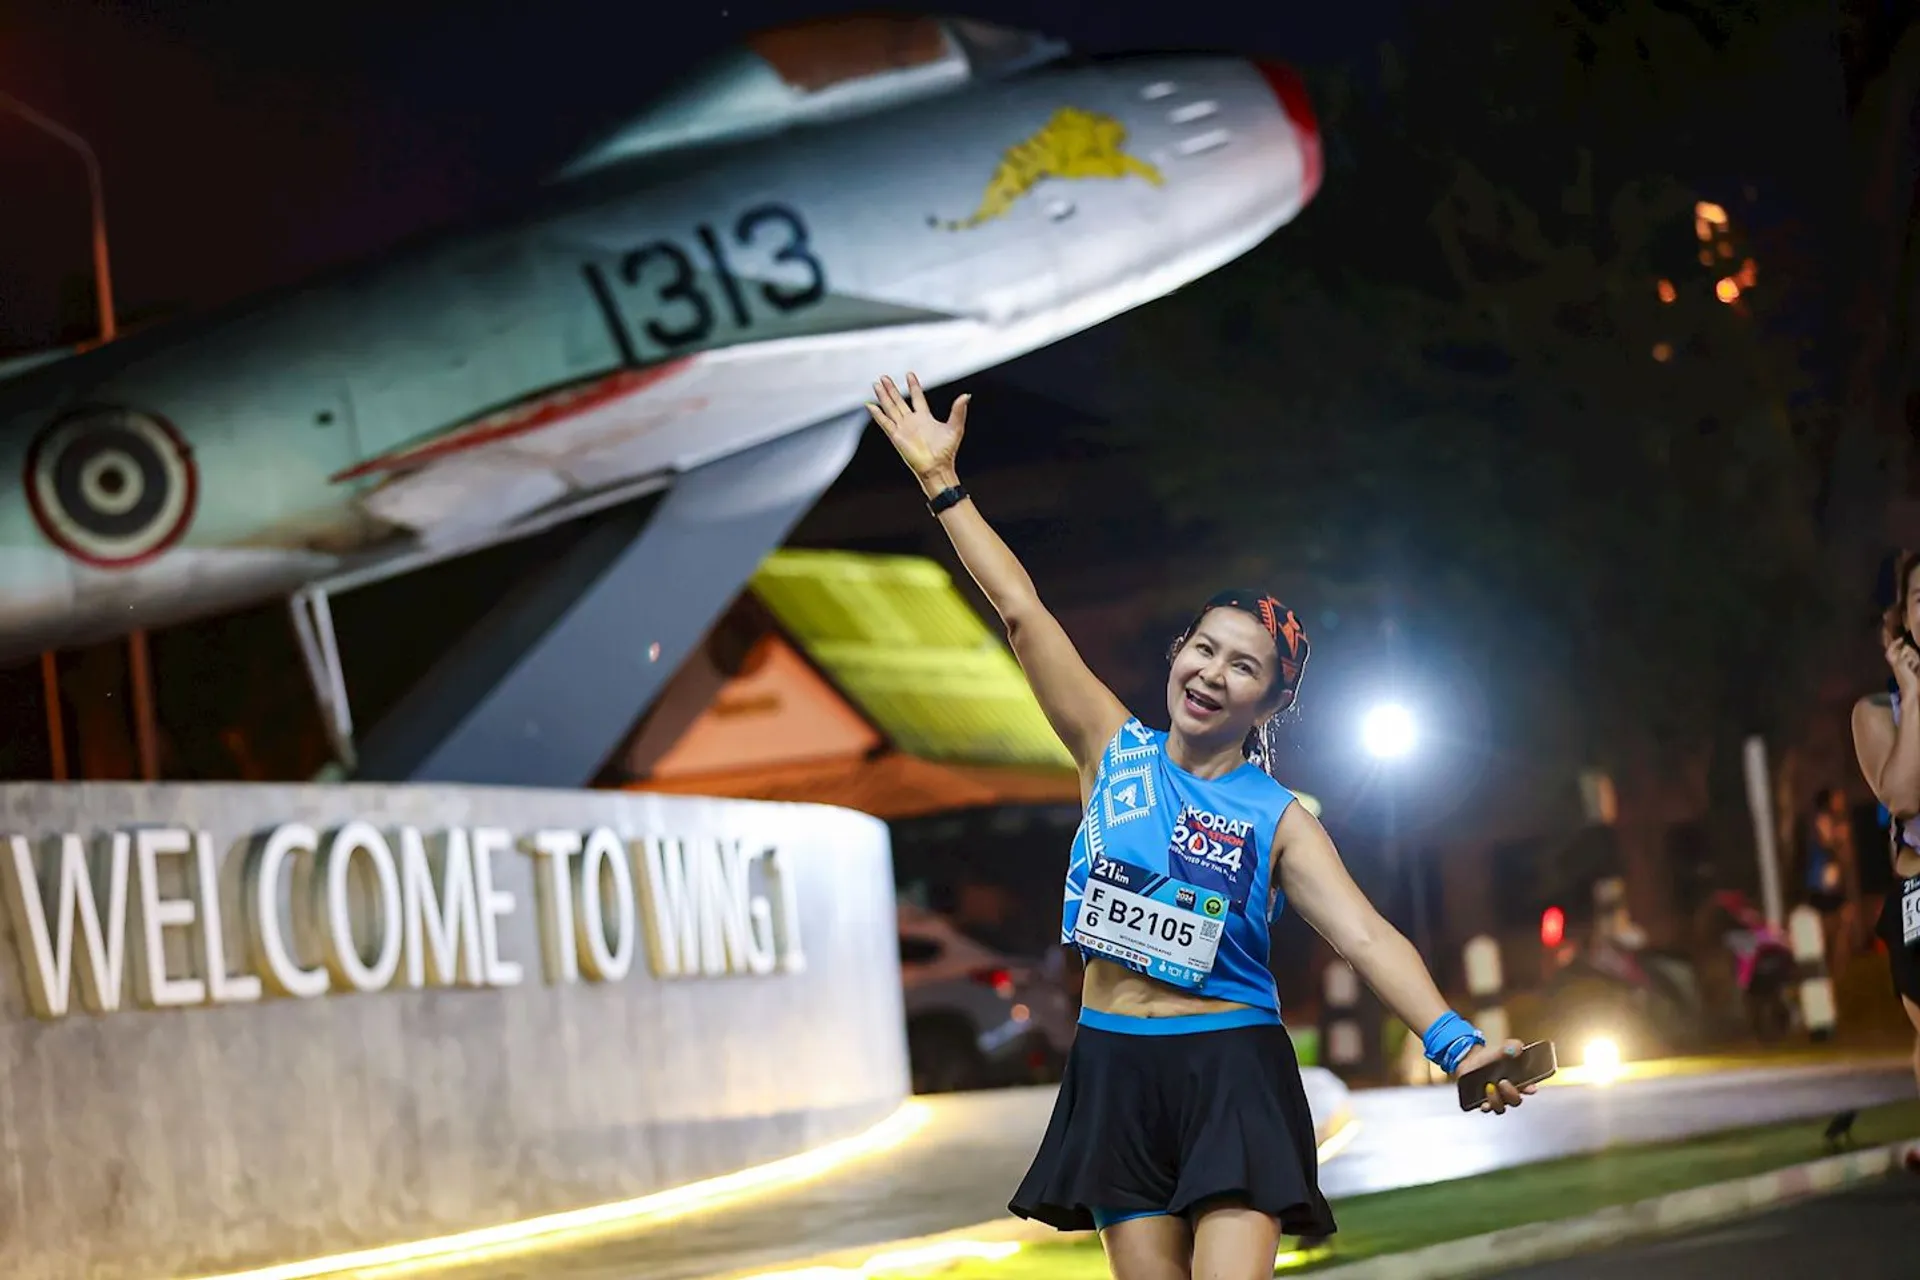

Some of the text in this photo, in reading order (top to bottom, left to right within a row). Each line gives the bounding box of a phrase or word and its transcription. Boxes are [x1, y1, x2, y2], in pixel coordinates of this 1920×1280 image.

[581, 202, 827, 368] 1313
[1187, 804, 1254, 838] KORAT
[1171, 825, 1242, 873] 2024
[1094, 859, 1130, 885] 21 km
[1092, 887, 1105, 903] F
[9, 821, 524, 1016] WELCOME
[534, 826, 635, 984] TO
[1086, 911, 1100, 927] 6
[1108, 898, 1195, 947] B2105
